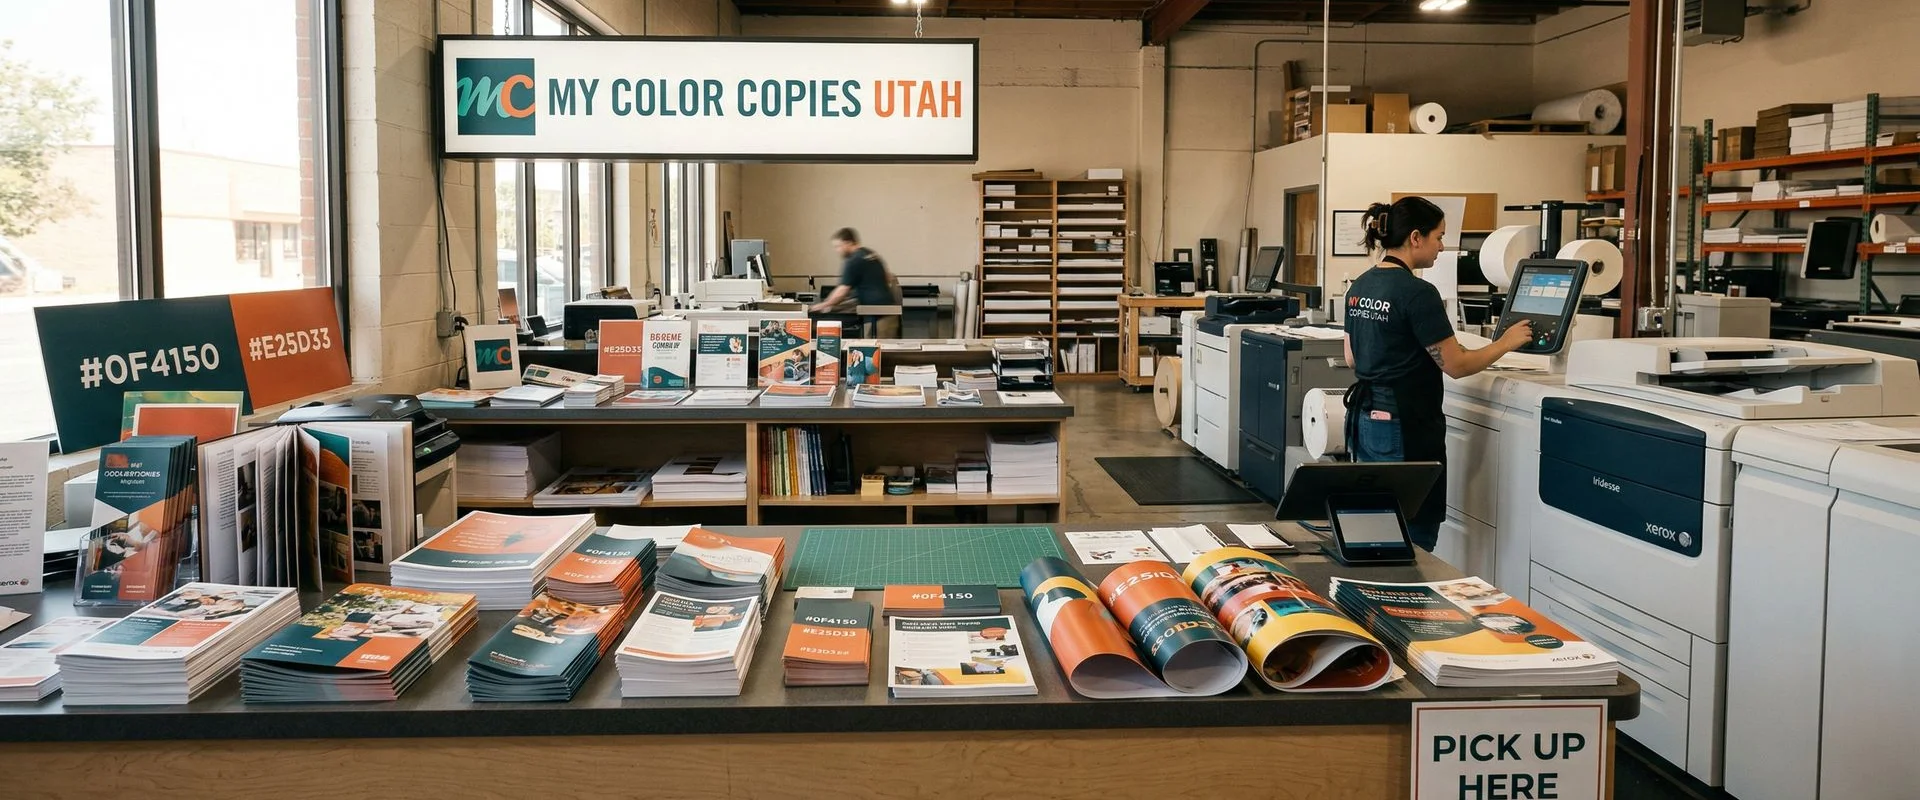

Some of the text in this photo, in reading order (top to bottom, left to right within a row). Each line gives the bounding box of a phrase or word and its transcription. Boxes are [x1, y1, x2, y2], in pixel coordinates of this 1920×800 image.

[548, 78, 962, 118] MY COLOR COPIES UTAH
[1349, 308, 1389, 322] COPIES UTAH
[1359, 297, 1391, 313] COLOR
[249, 327, 332, 361] #E25D33
[1592, 475, 1621, 493] Iridesse
[1645, 522, 1676, 542] xerox
[803, 628, 857, 637] #E25D33
[1433, 732, 1586, 762] PICK UP
[1459, 772, 1558, 800] HERE
